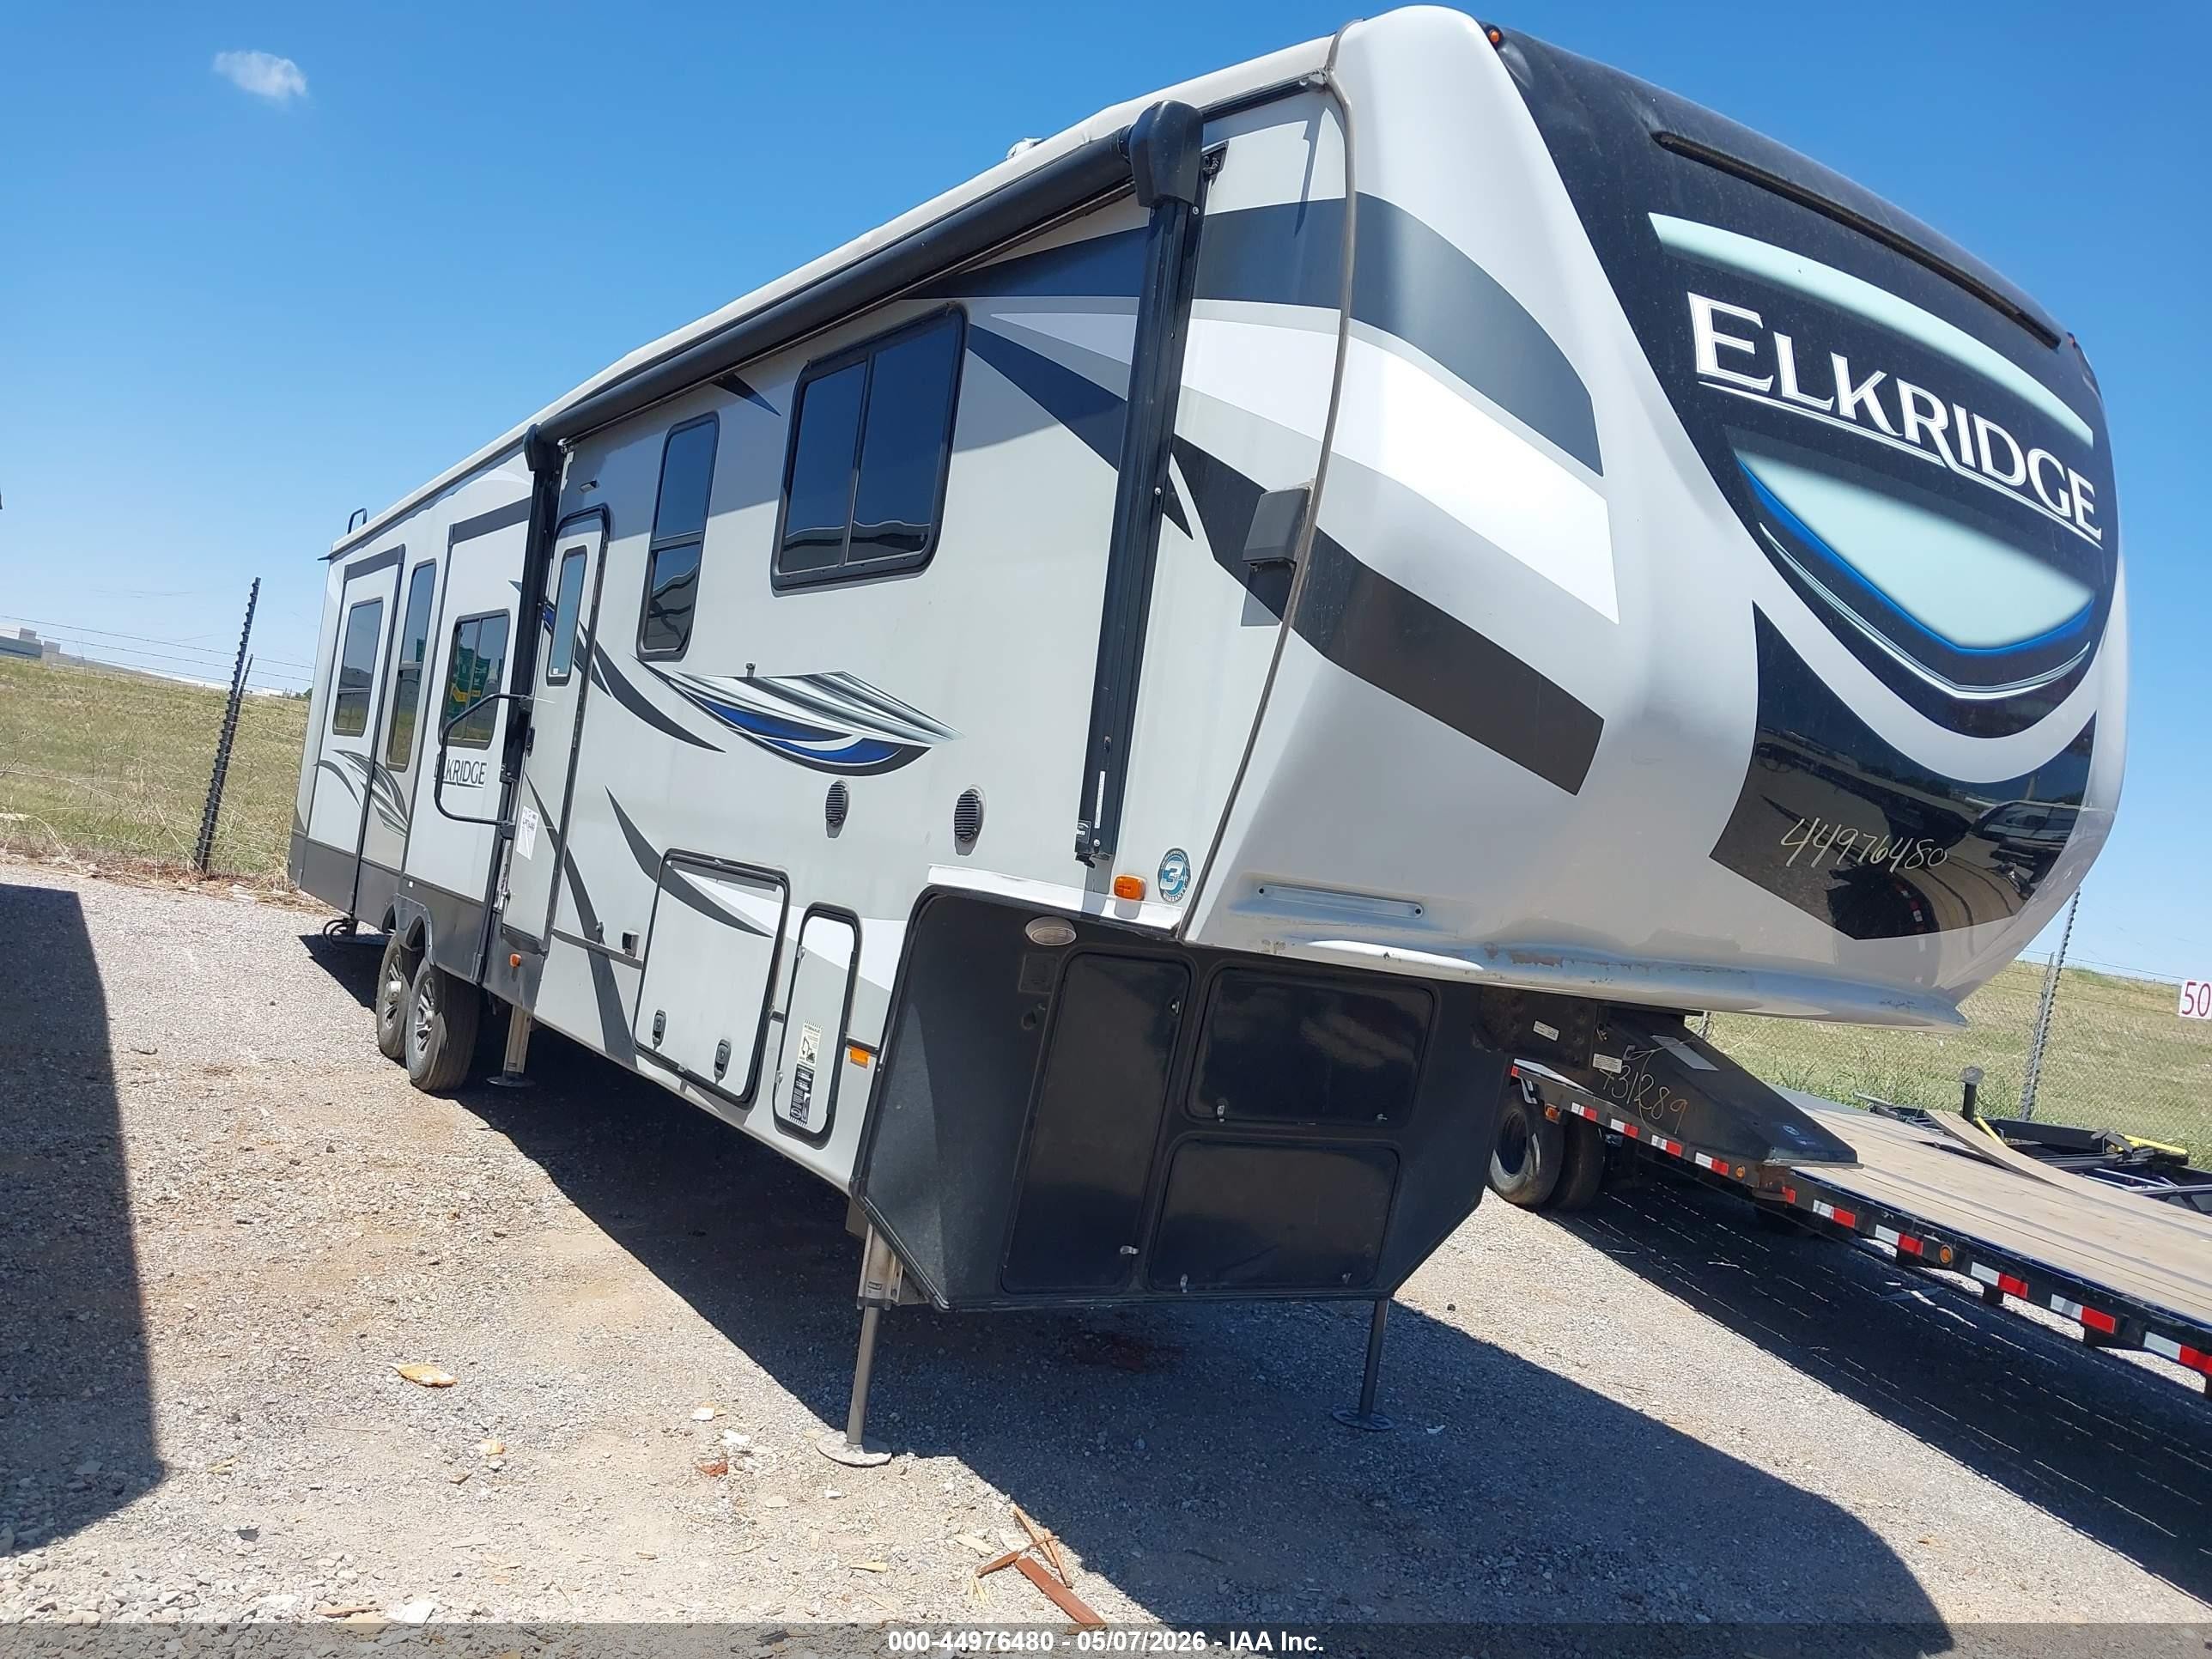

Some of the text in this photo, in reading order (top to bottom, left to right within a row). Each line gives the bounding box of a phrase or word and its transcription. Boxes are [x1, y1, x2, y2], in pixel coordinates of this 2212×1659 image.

[1687, 291, 2103, 543] ELKRIDGE
[434, 754, 488, 785] KRIDGE
[1781, 817, 1948, 872] 44976480
[1161, 860, 1184, 890] 3
[2182, 981, 2211, 1017] 50
